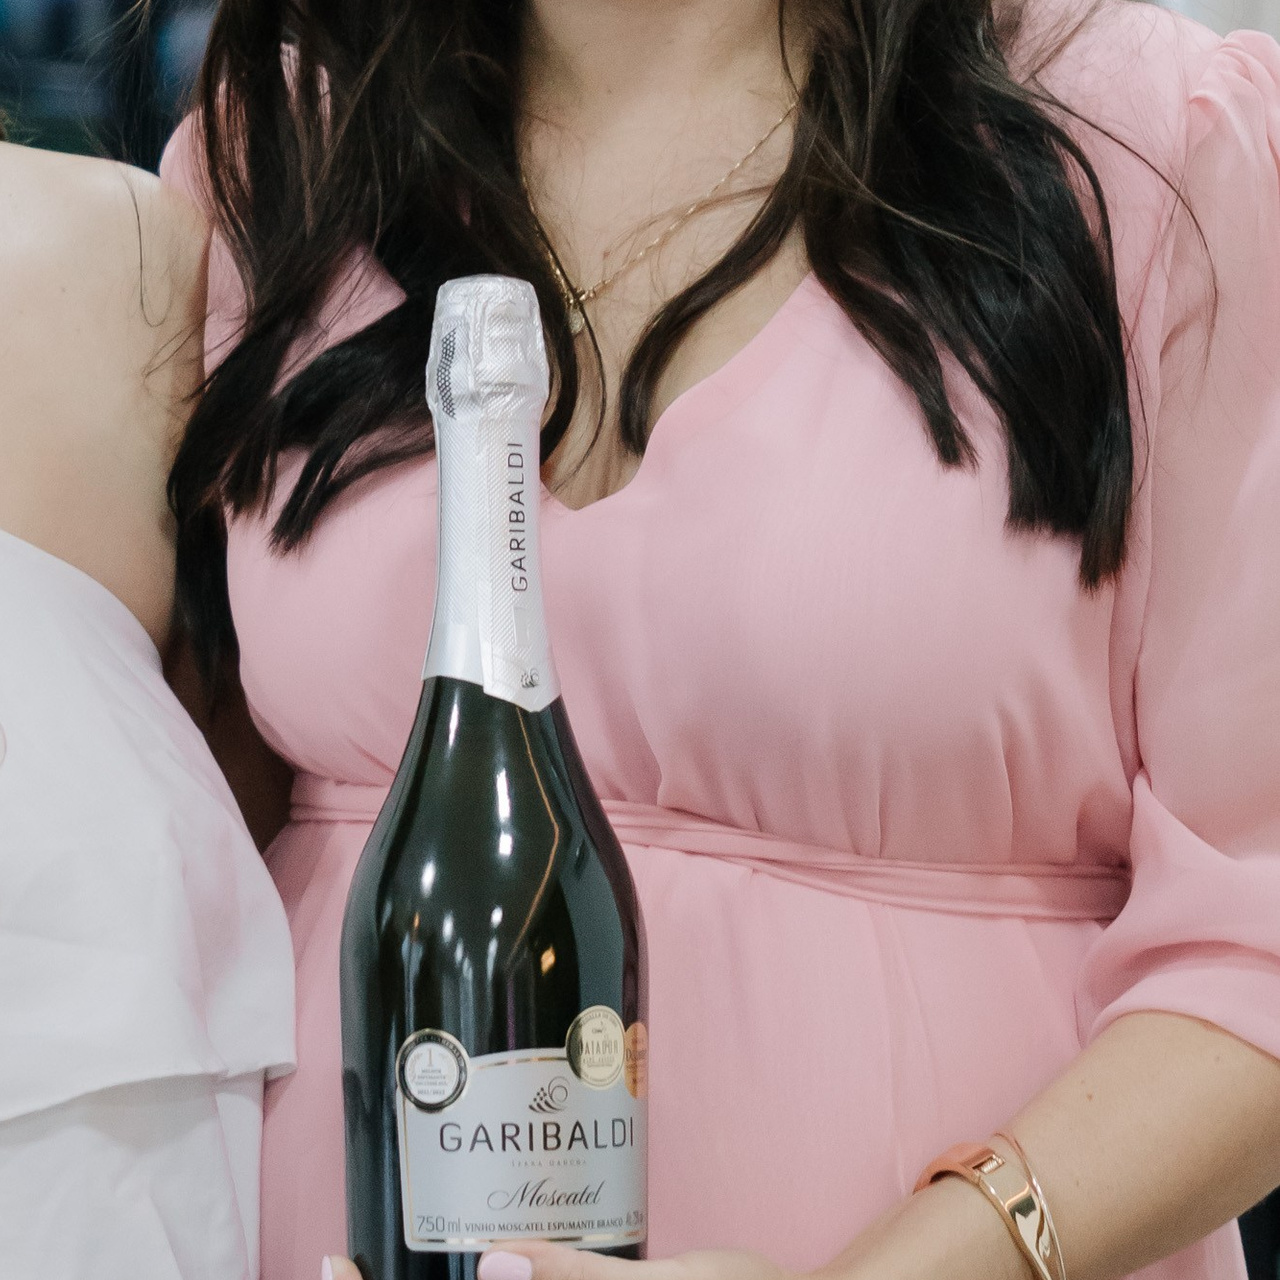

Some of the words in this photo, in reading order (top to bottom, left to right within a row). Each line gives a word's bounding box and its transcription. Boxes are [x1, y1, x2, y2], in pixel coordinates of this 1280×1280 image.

[507, 443, 528, 592] GARIBALDI
[439, 1116, 634, 1153] GARIBALDI
[486, 1177, 606, 1211] Moscatel
[417, 1215, 445, 1233] 750
[448, 1217, 461, 1233] ml
[465, 1222, 496, 1232] VINHO
[498, 1221, 545, 1232] MOSCATEL
[547, 1220, 595, 1231] ESPUMANTE
